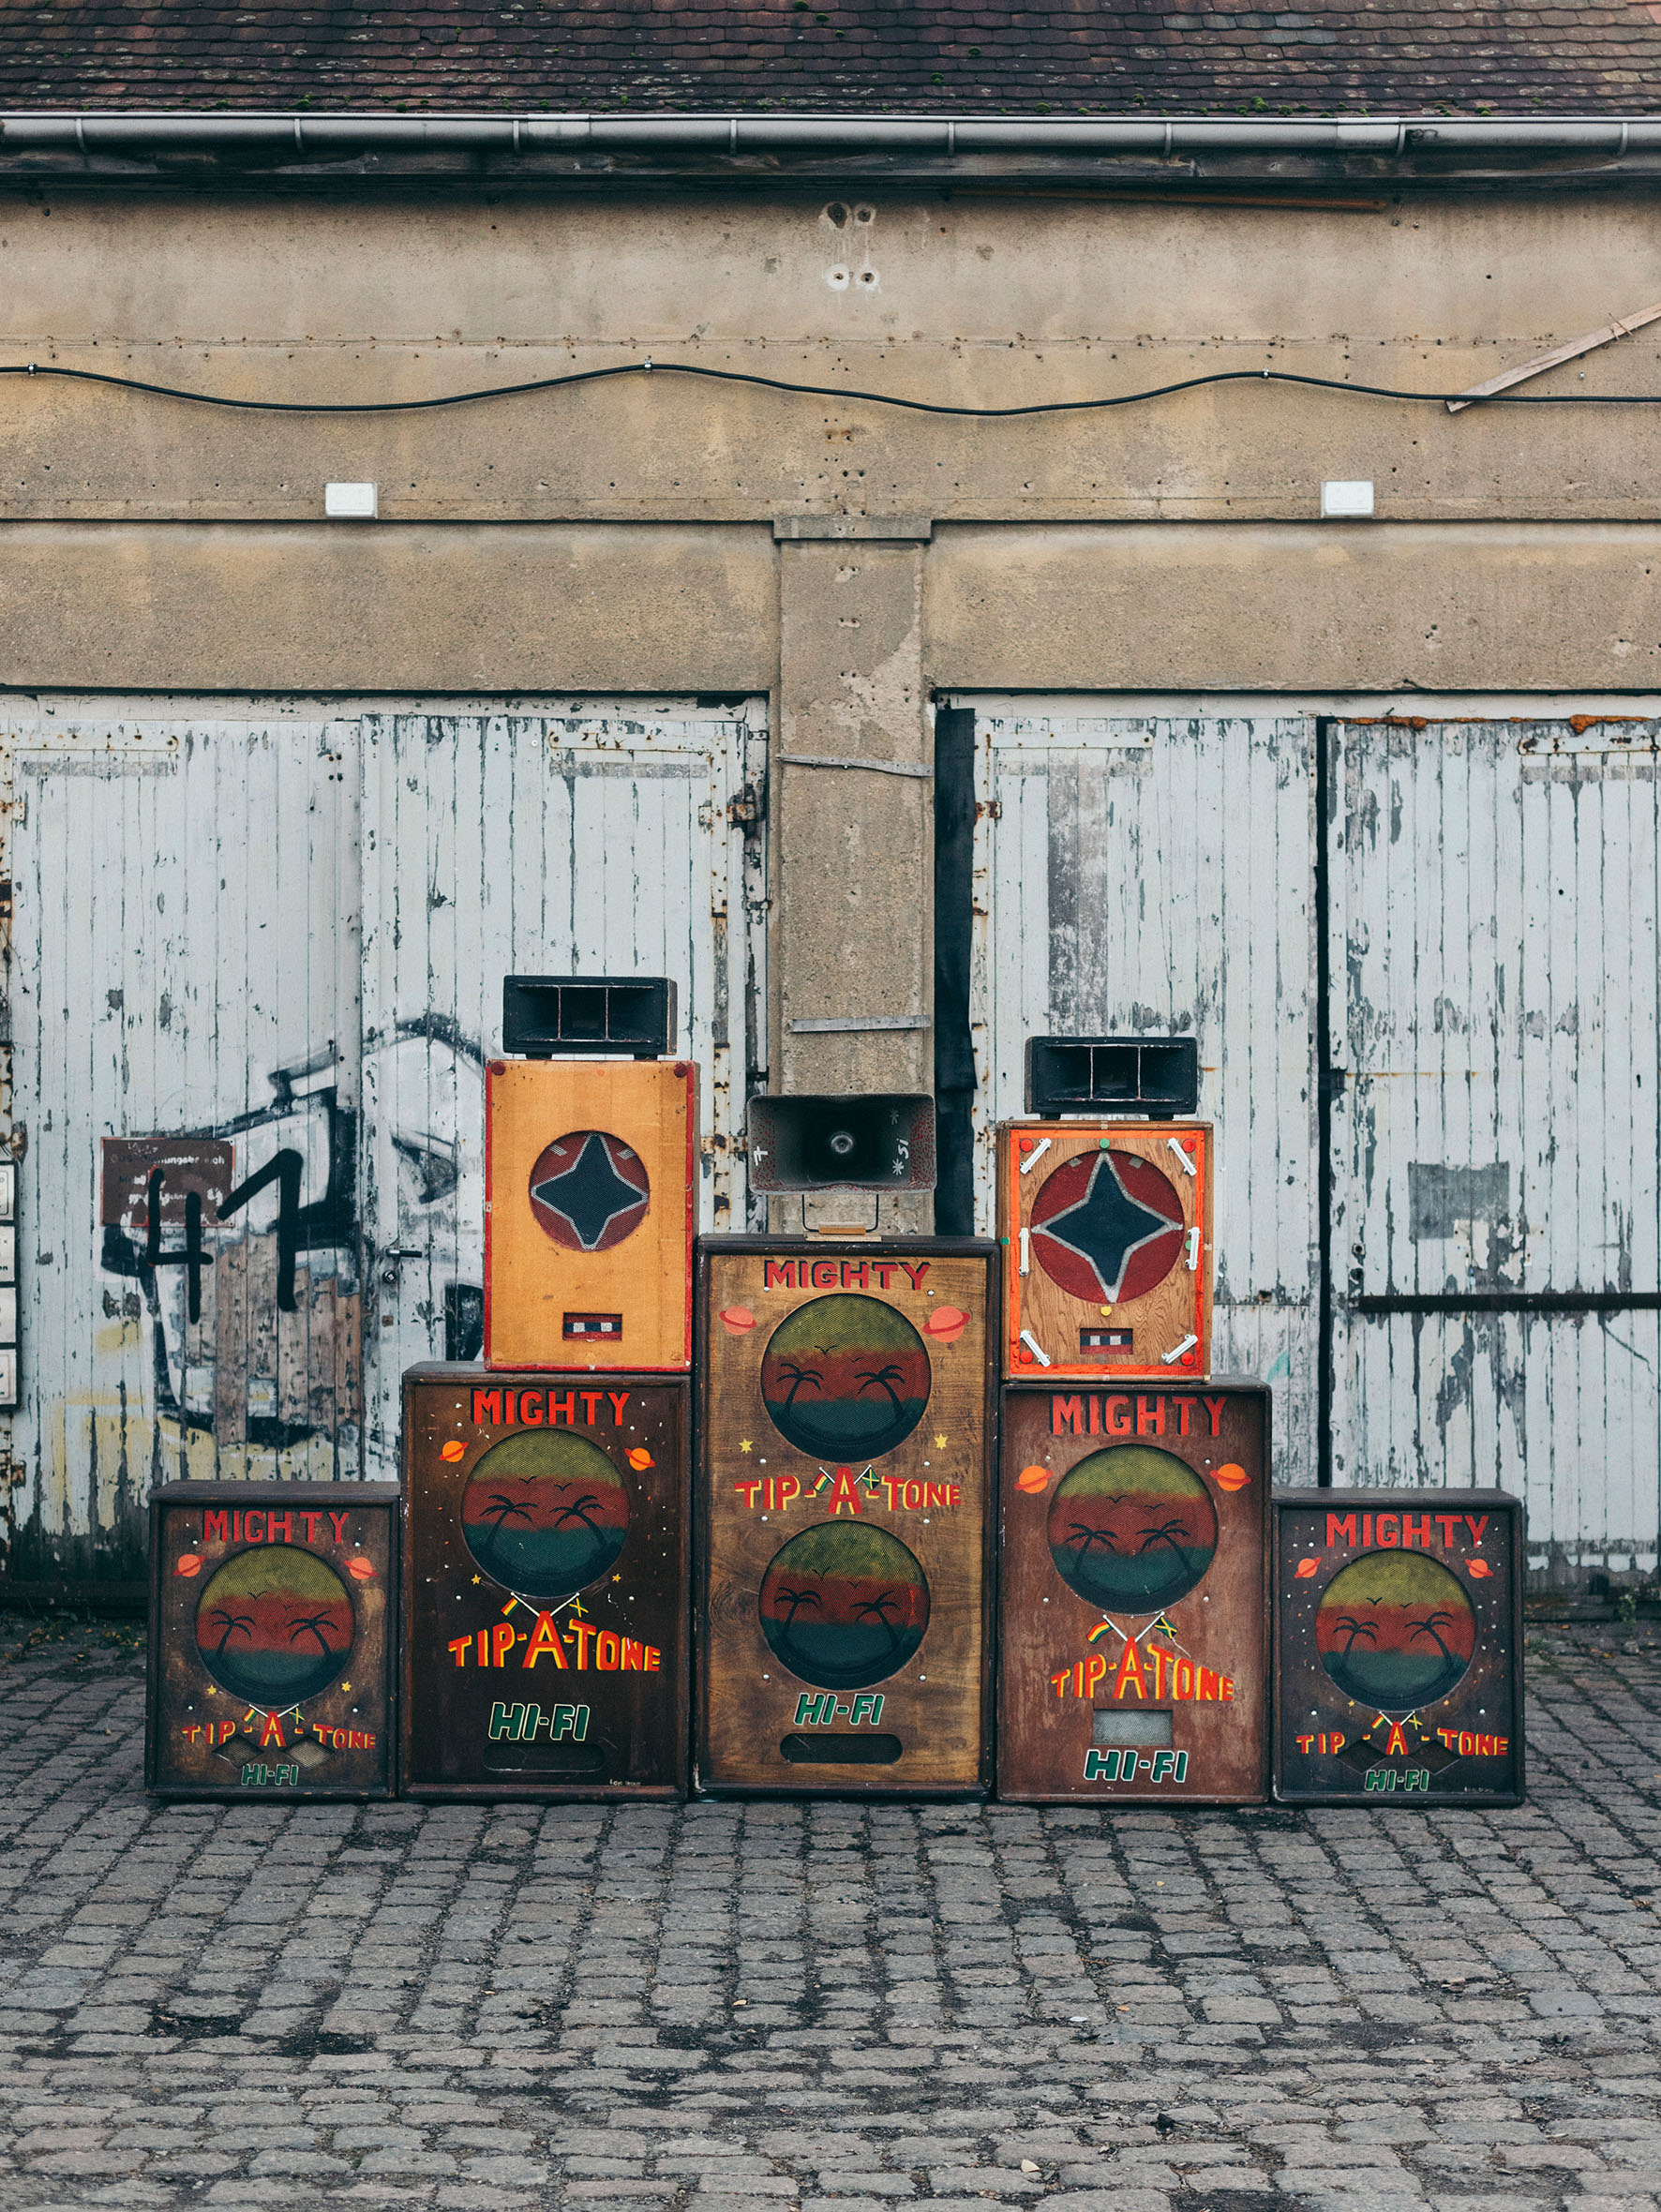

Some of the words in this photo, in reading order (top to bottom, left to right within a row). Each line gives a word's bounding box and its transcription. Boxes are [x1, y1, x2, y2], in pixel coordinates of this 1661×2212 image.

[764, 1259, 931, 1291] MIGHTY
[471, 1388, 632, 1427] MIGHTY
[1051, 1395, 1229, 1436] MIGHTY
[202, 1509, 351, 1546] MIGHTY
[1325, 1513, 1490, 1548] MIGHTY
[447, 1609, 662, 1672] TIP-A-TONE
[1050, 1636, 1236, 1702] TIP-A-TONE
[487, 1700, 591, 1742] HI-FI
[793, 1693, 886, 1726] HI-FI
[239, 1763, 300, 1787] HI-FI
[1083, 1748, 1190, 1784] HI-FI
[1363, 1769, 1430, 1792] HI-FI
